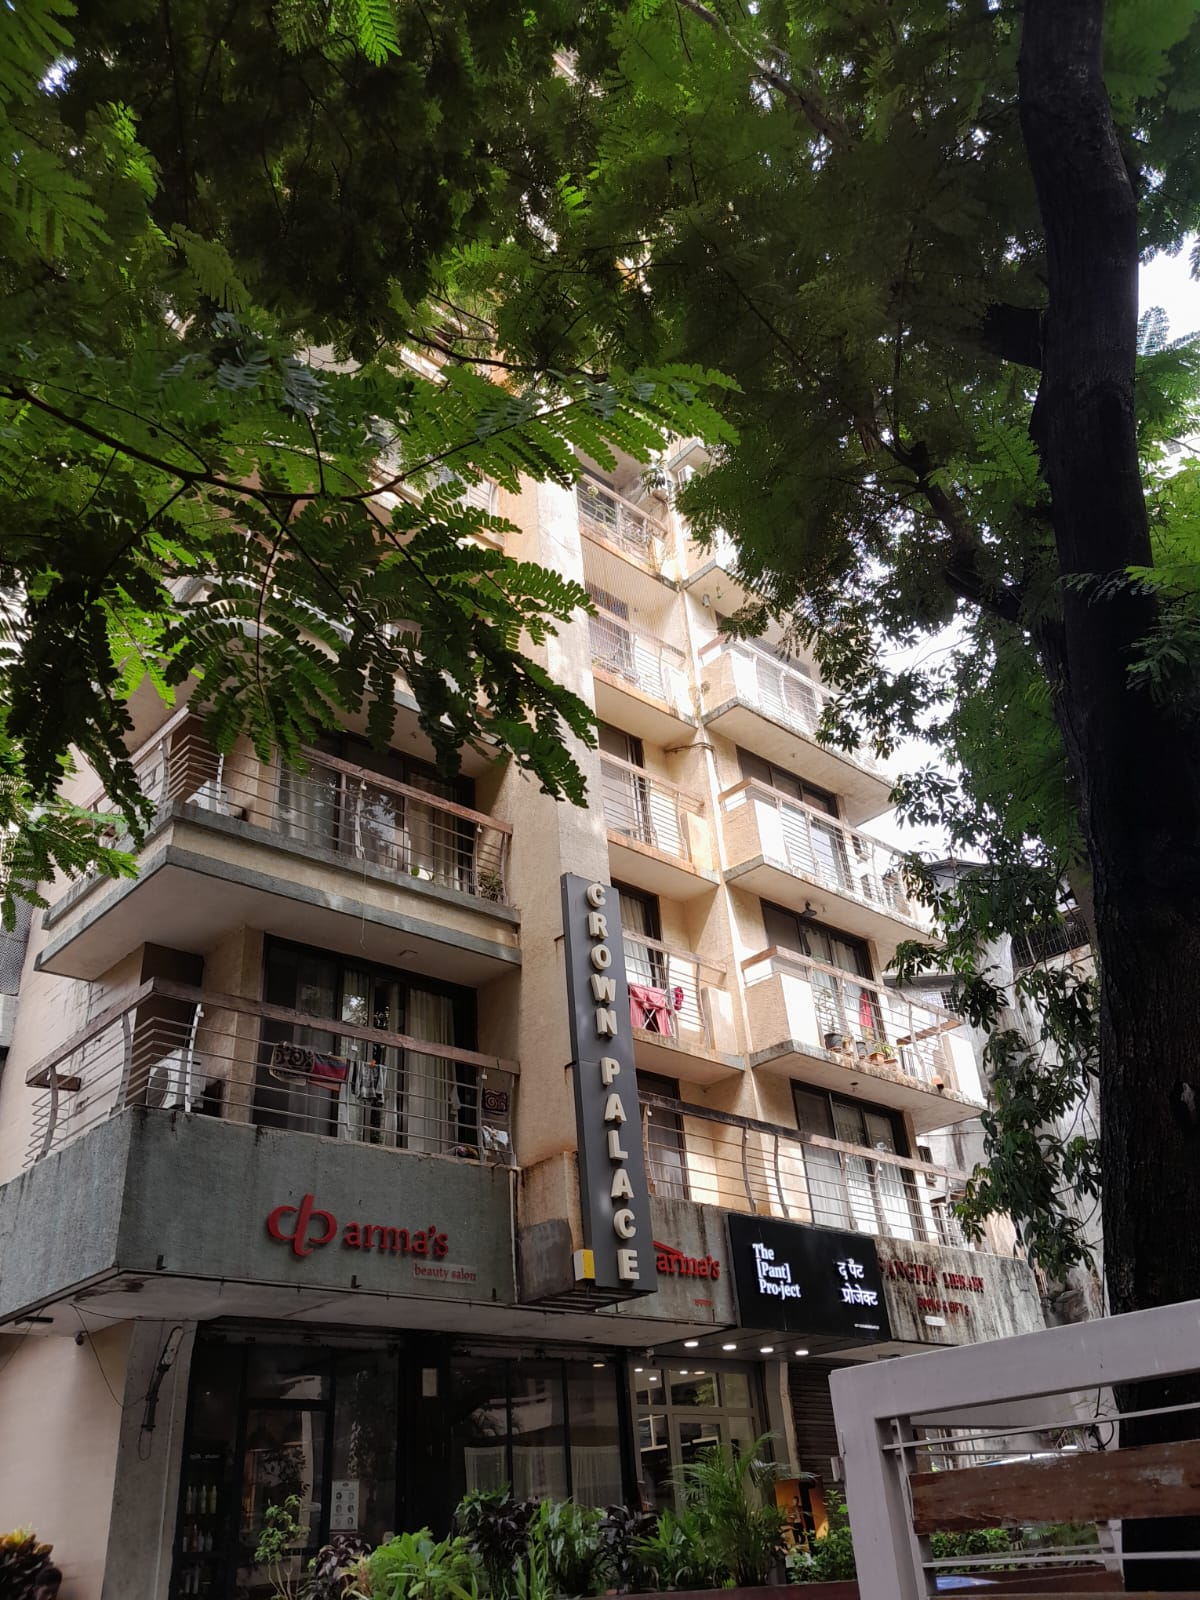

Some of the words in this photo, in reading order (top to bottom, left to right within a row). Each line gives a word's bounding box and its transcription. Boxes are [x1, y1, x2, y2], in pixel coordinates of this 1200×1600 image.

[586, 882, 618, 1038] CROWN
[601, 1056, 640, 1280] PALACE
[752, 1243, 775, 1260] The
[414, 1263, 449, 1278] beauty
[450, 1267, 477, 1281] salon
[756, 1259, 791, 1283] [Pant]
[837, 1261, 848, 1280] द
